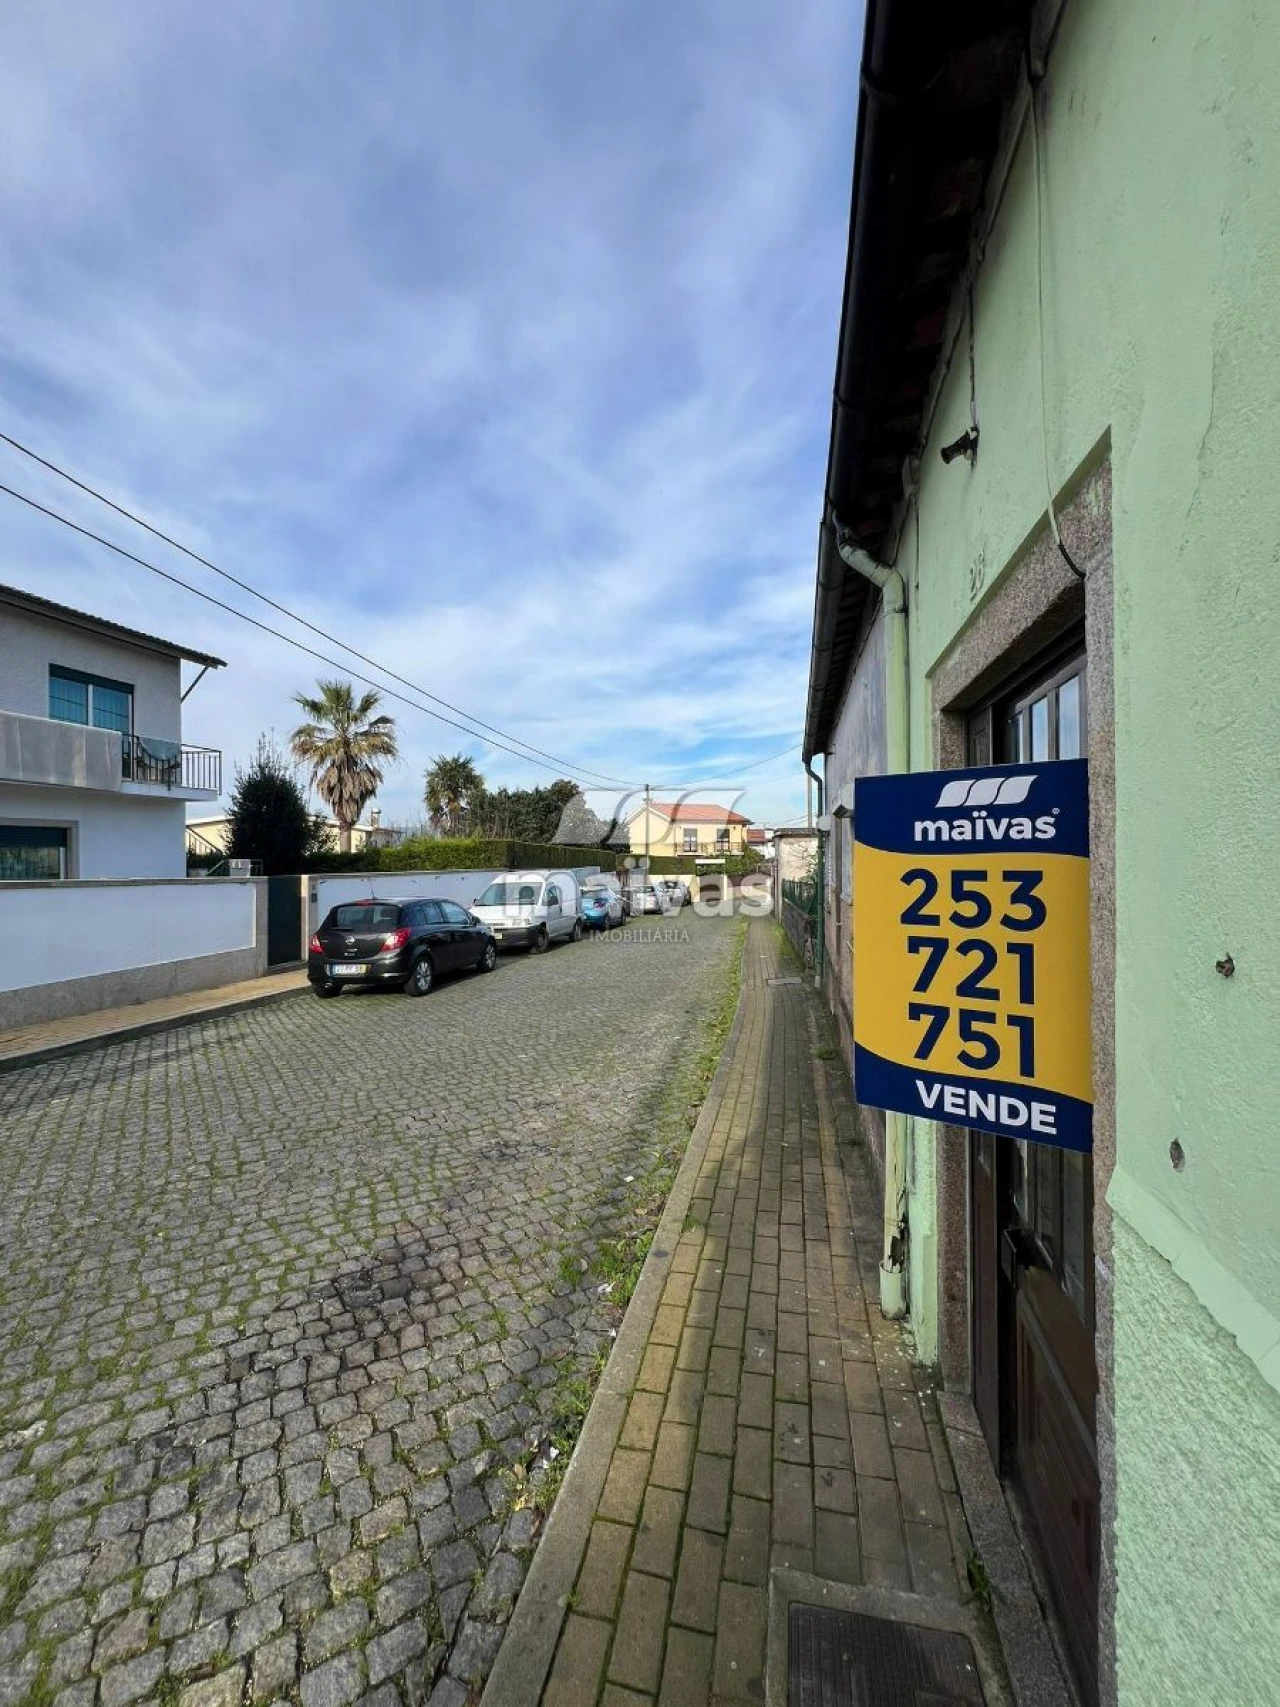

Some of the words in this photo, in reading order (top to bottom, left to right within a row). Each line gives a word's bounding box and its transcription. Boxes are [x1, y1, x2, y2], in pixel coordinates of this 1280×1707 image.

[900, 868, 1047, 932] 253
[907, 935, 1035, 1005] 721
[908, 1002, 1035, 1079] 751
[915, 1079, 1057, 1135] VENDE
